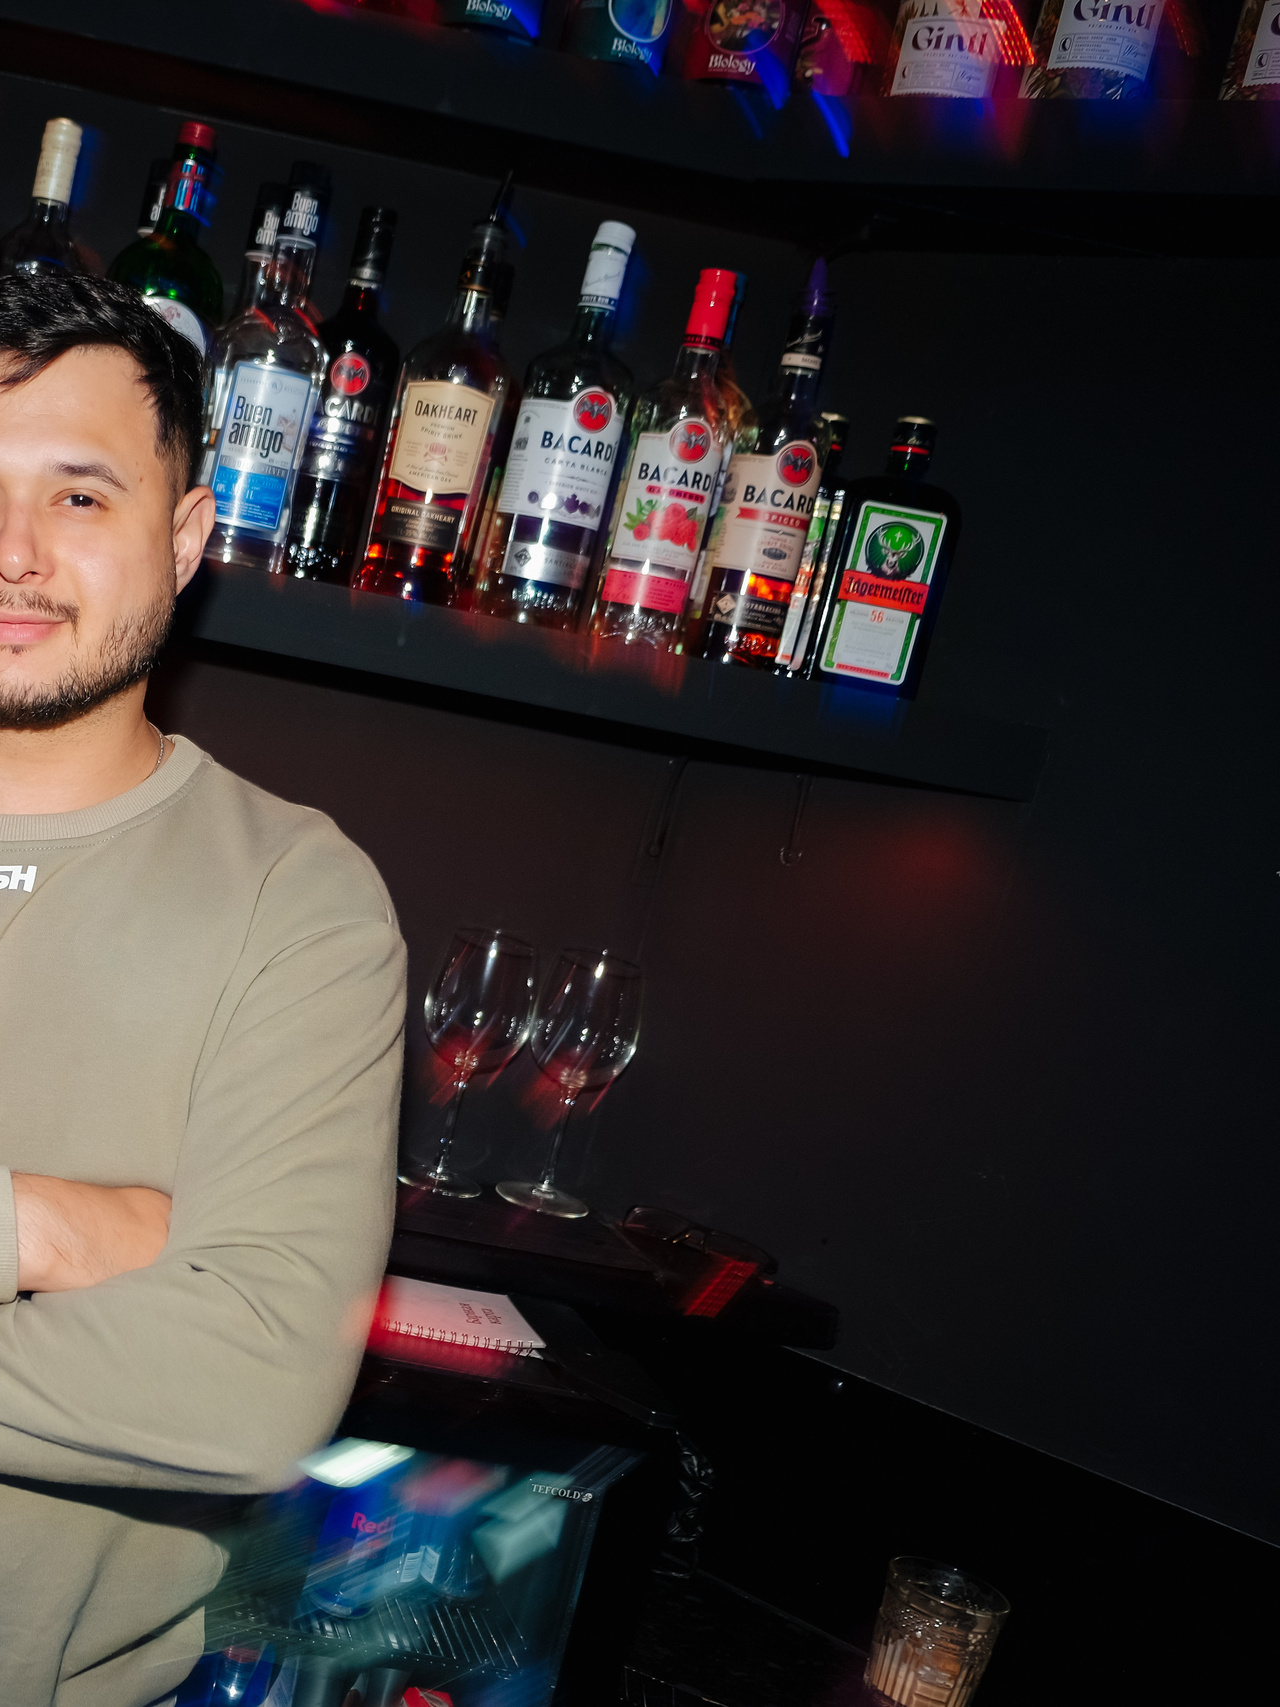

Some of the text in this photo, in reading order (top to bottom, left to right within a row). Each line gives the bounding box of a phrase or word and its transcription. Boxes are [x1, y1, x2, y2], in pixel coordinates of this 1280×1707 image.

[612, 37, 653, 64] Biology
[708, 54, 757, 76] Biology
[292, 191, 319, 215] Buen
[263, 209, 280, 231] Bu
[283, 210, 319, 236] amigo
[233, 395, 272, 426] Buen
[322, 396, 380, 425] CARDÍ
[414, 400, 478, 425] OAKHEART
[228, 422, 283, 459] amigo
[391, 504, 419, 517] ORIGINAL
[743, 485, 815, 516] BACARD
[869, 610, 884, 623] 56
[531, 1483, 581, 1500] TEFCOLD
